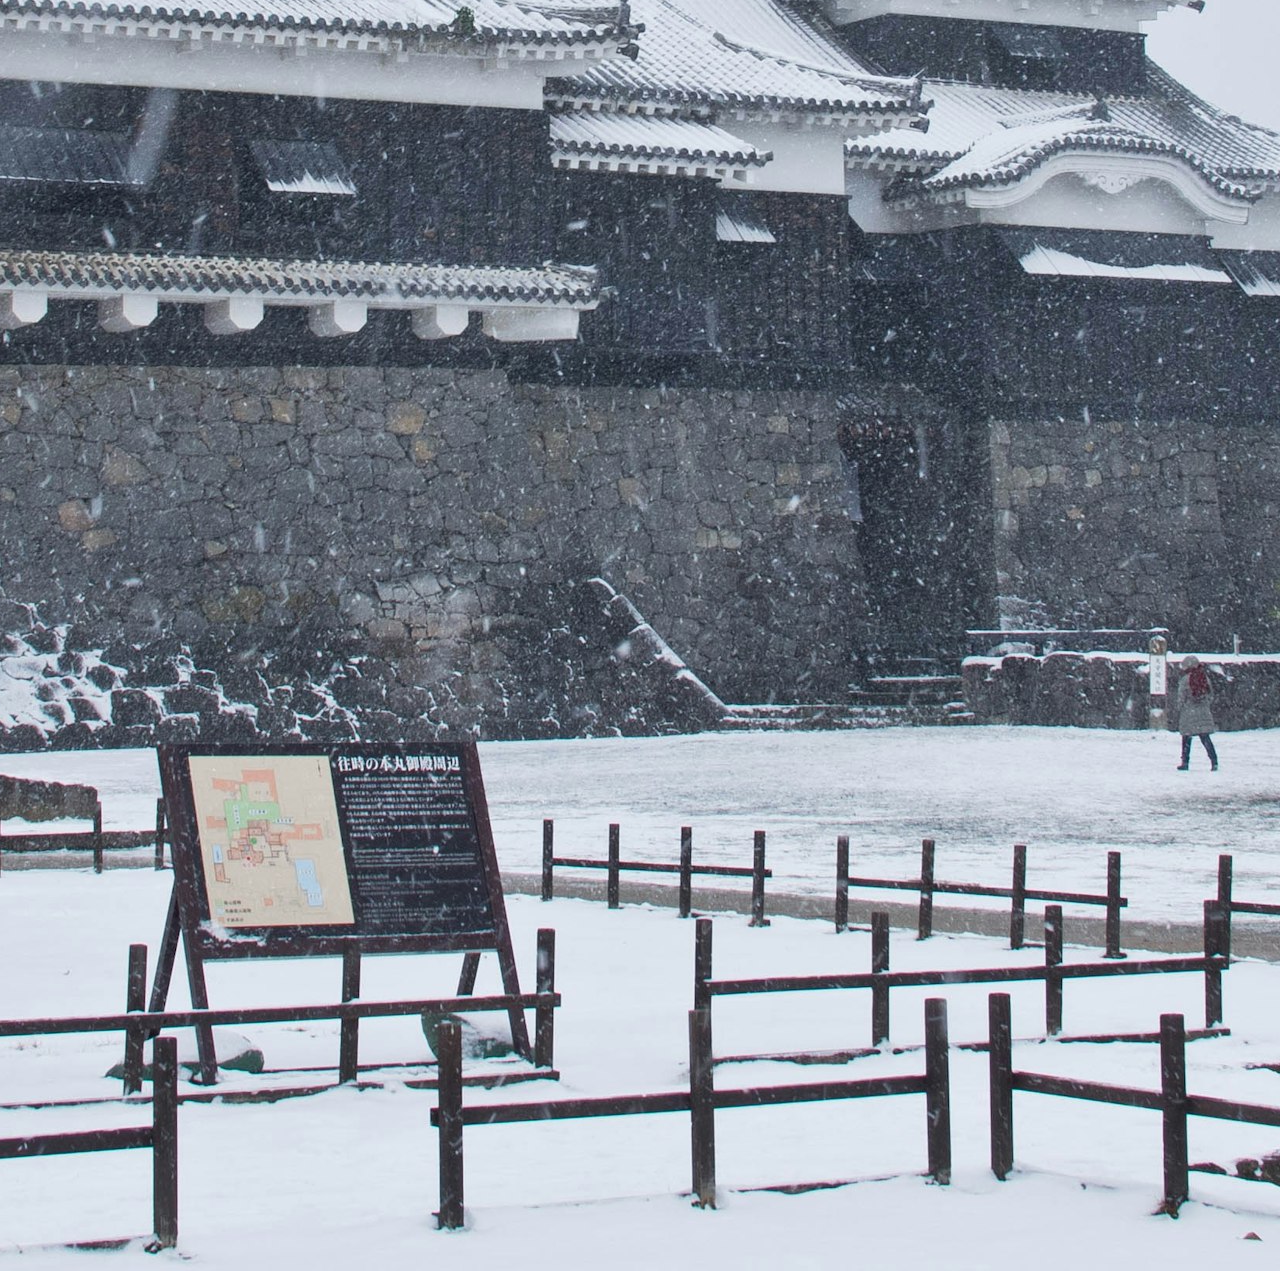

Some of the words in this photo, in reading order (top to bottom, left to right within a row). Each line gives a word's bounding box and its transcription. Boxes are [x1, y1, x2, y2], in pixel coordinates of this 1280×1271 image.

[338, 755, 460, 772] 往時の本丸御殿周辺
